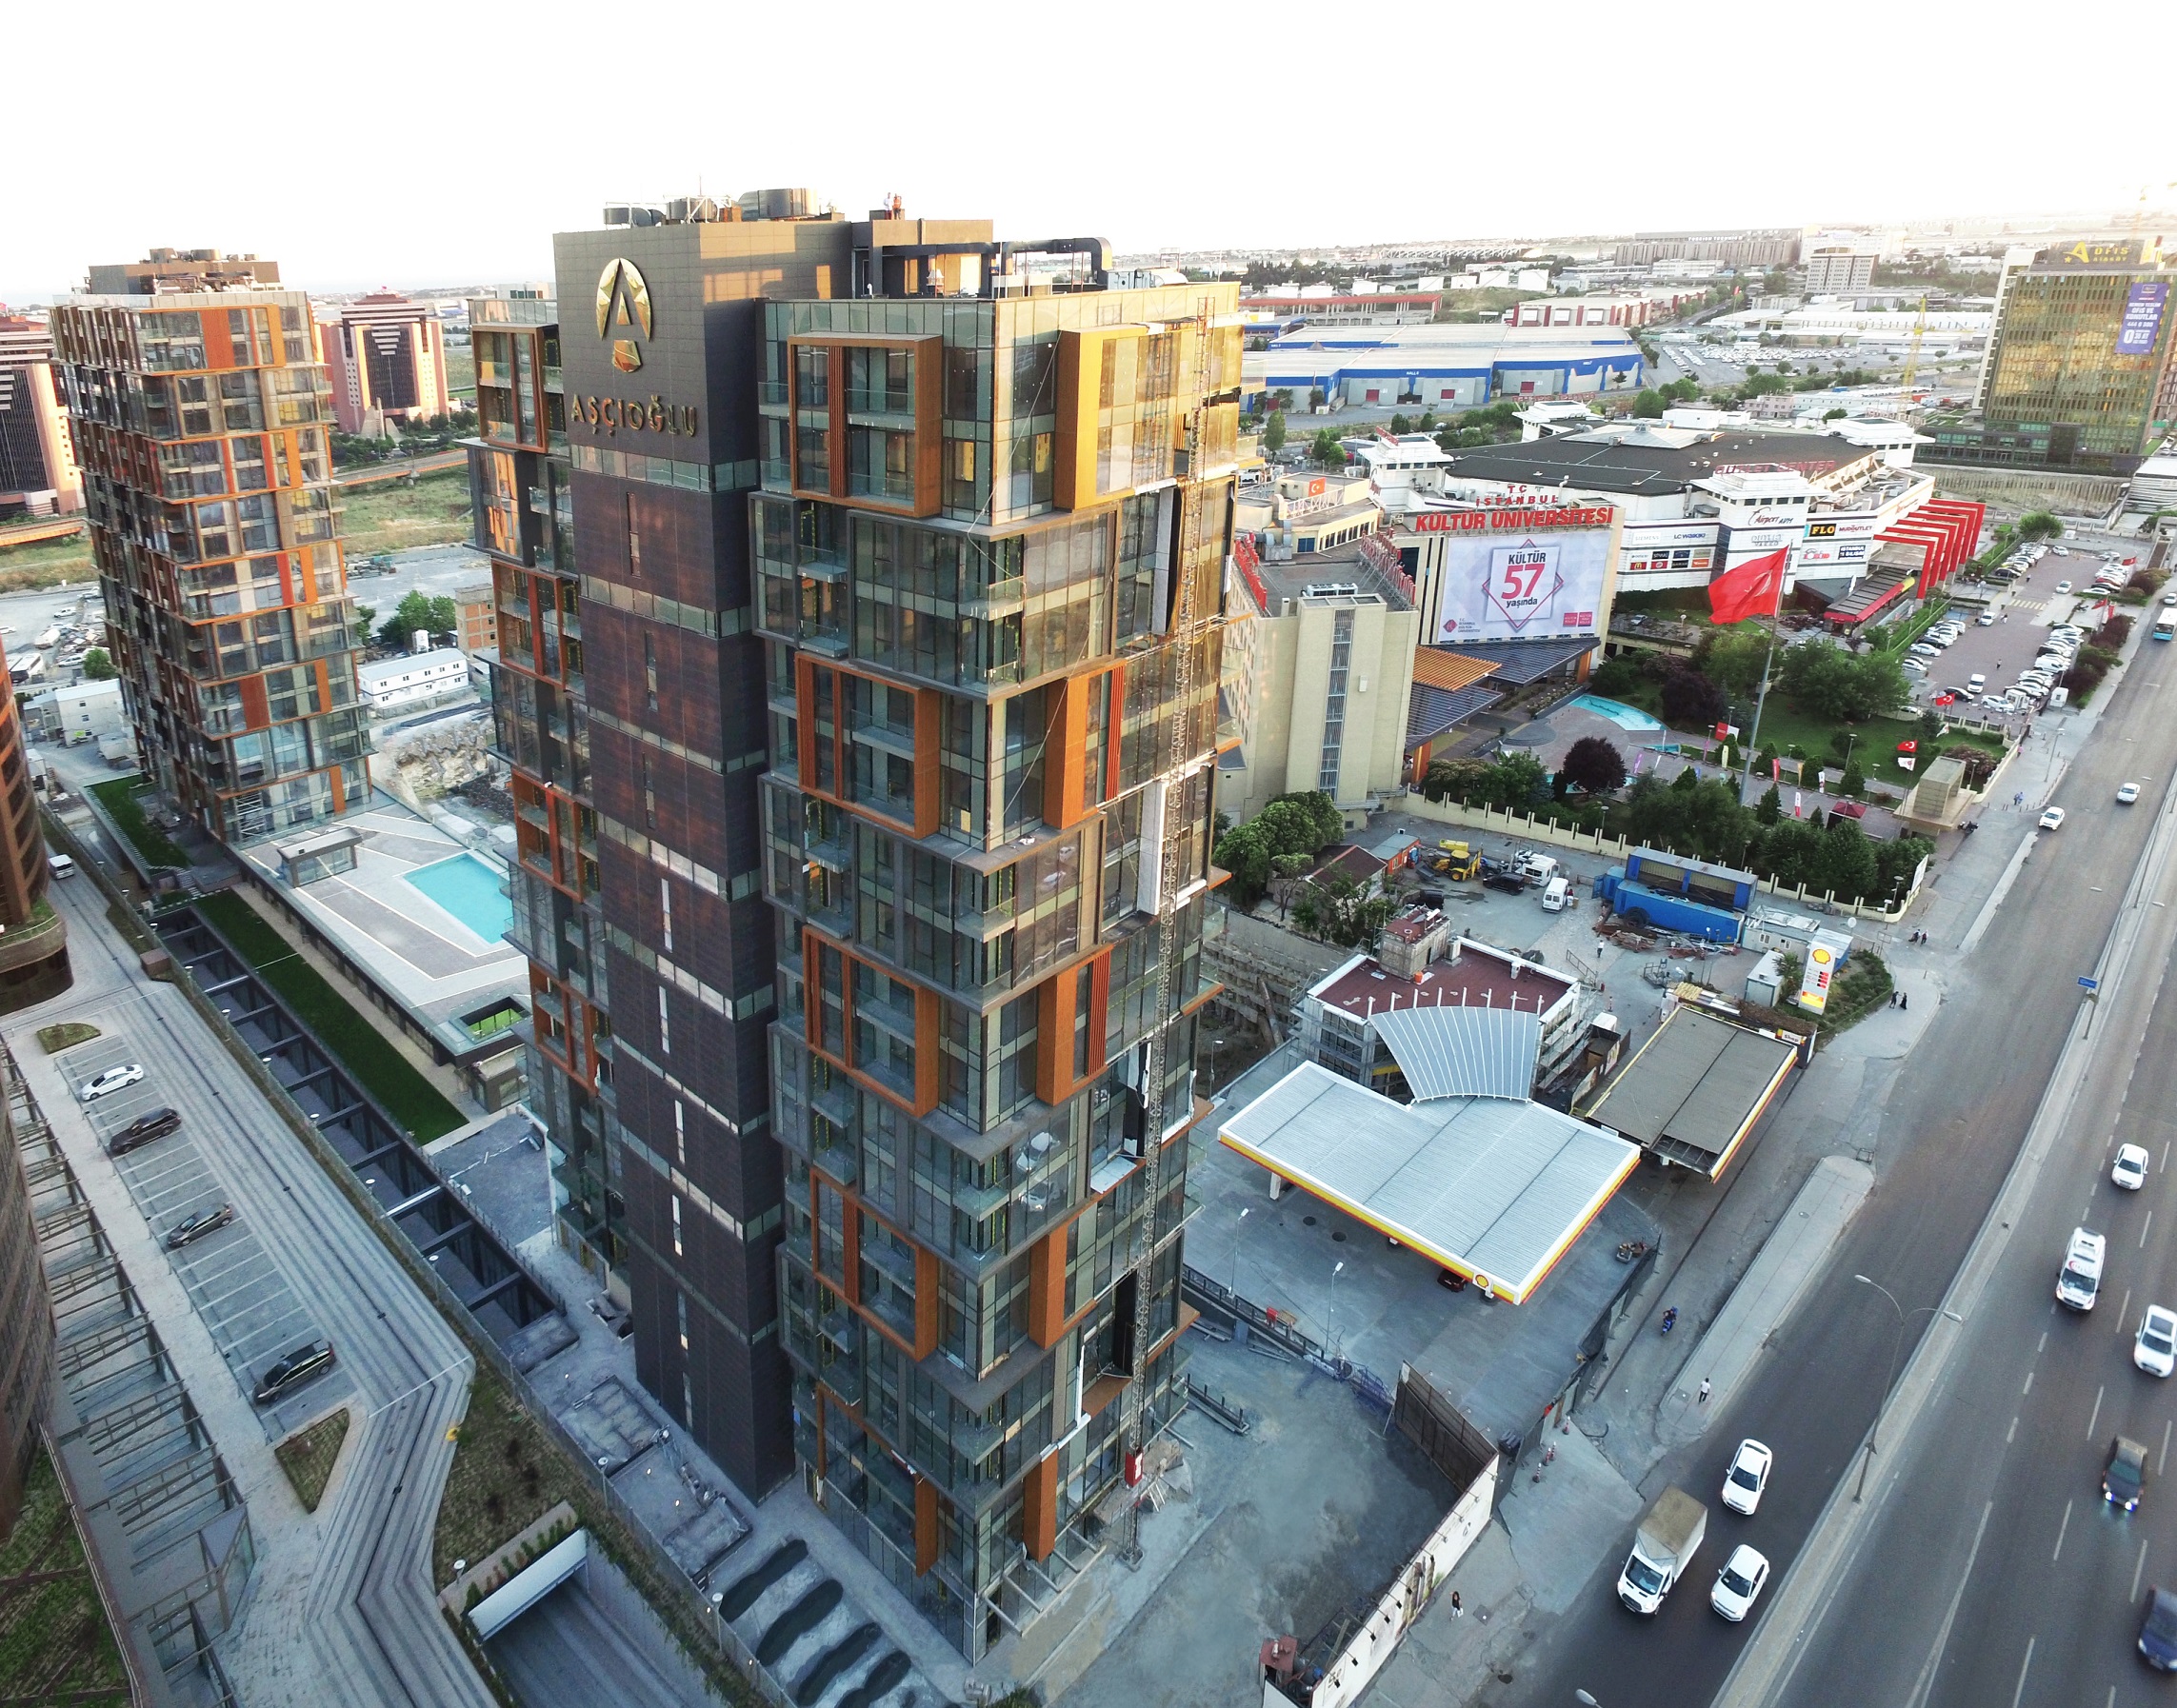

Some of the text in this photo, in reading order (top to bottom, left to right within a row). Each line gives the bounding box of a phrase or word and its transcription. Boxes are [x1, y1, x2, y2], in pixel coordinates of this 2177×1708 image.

[571, 393, 697, 438] AŞÇIOĞLU
[1715, 461, 1837, 475] OUTLET CENTER
[1476, 494, 1559, 506] İSTANBUL
[1415, 509, 1486, 532] KÜLTÜR
[1811, 526, 1835, 535] FLO
[1508, 550, 1547, 565] KÜLTÜR
[1501, 564, 1546, 600] 57
[1506, 597, 1538, 608] yaşında
